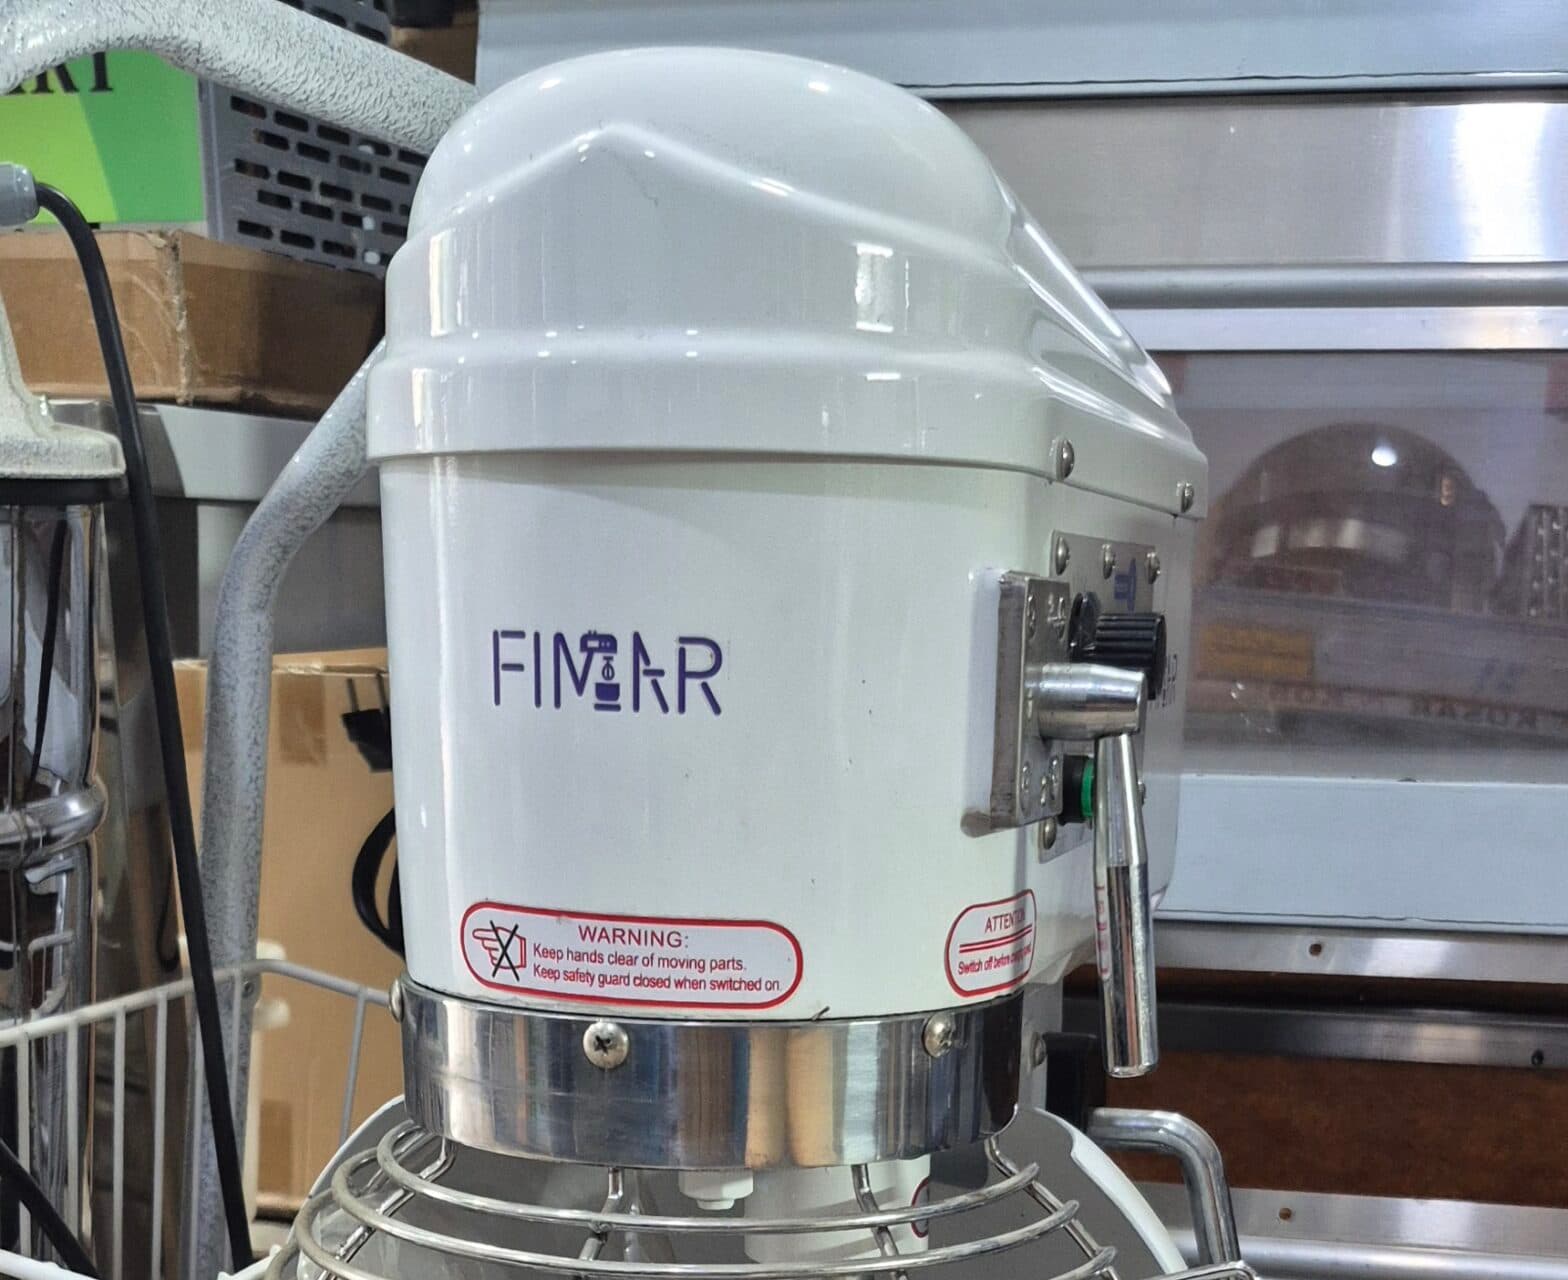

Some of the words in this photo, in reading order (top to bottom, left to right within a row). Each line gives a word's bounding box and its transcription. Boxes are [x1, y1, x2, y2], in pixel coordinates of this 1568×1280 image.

[492, 629, 723, 716] FIMAR
[578, 925, 689, 948] WARNING:
[533, 943, 564, 963] Keep
[566, 947, 605, 964] hands
[608, 951, 639, 966] clear
[641, 952, 655, 967] of
[657, 955, 706, 973] moving
[710, 957, 747, 973] parts.
[533, 963, 561, 982] Keep
[563, 968, 595, 986] safety
[597, 971, 631, 987] guard
[633, 972, 672, 989] closed
[674, 976, 707, 990] when
[710, 977, 762, 991] switched
